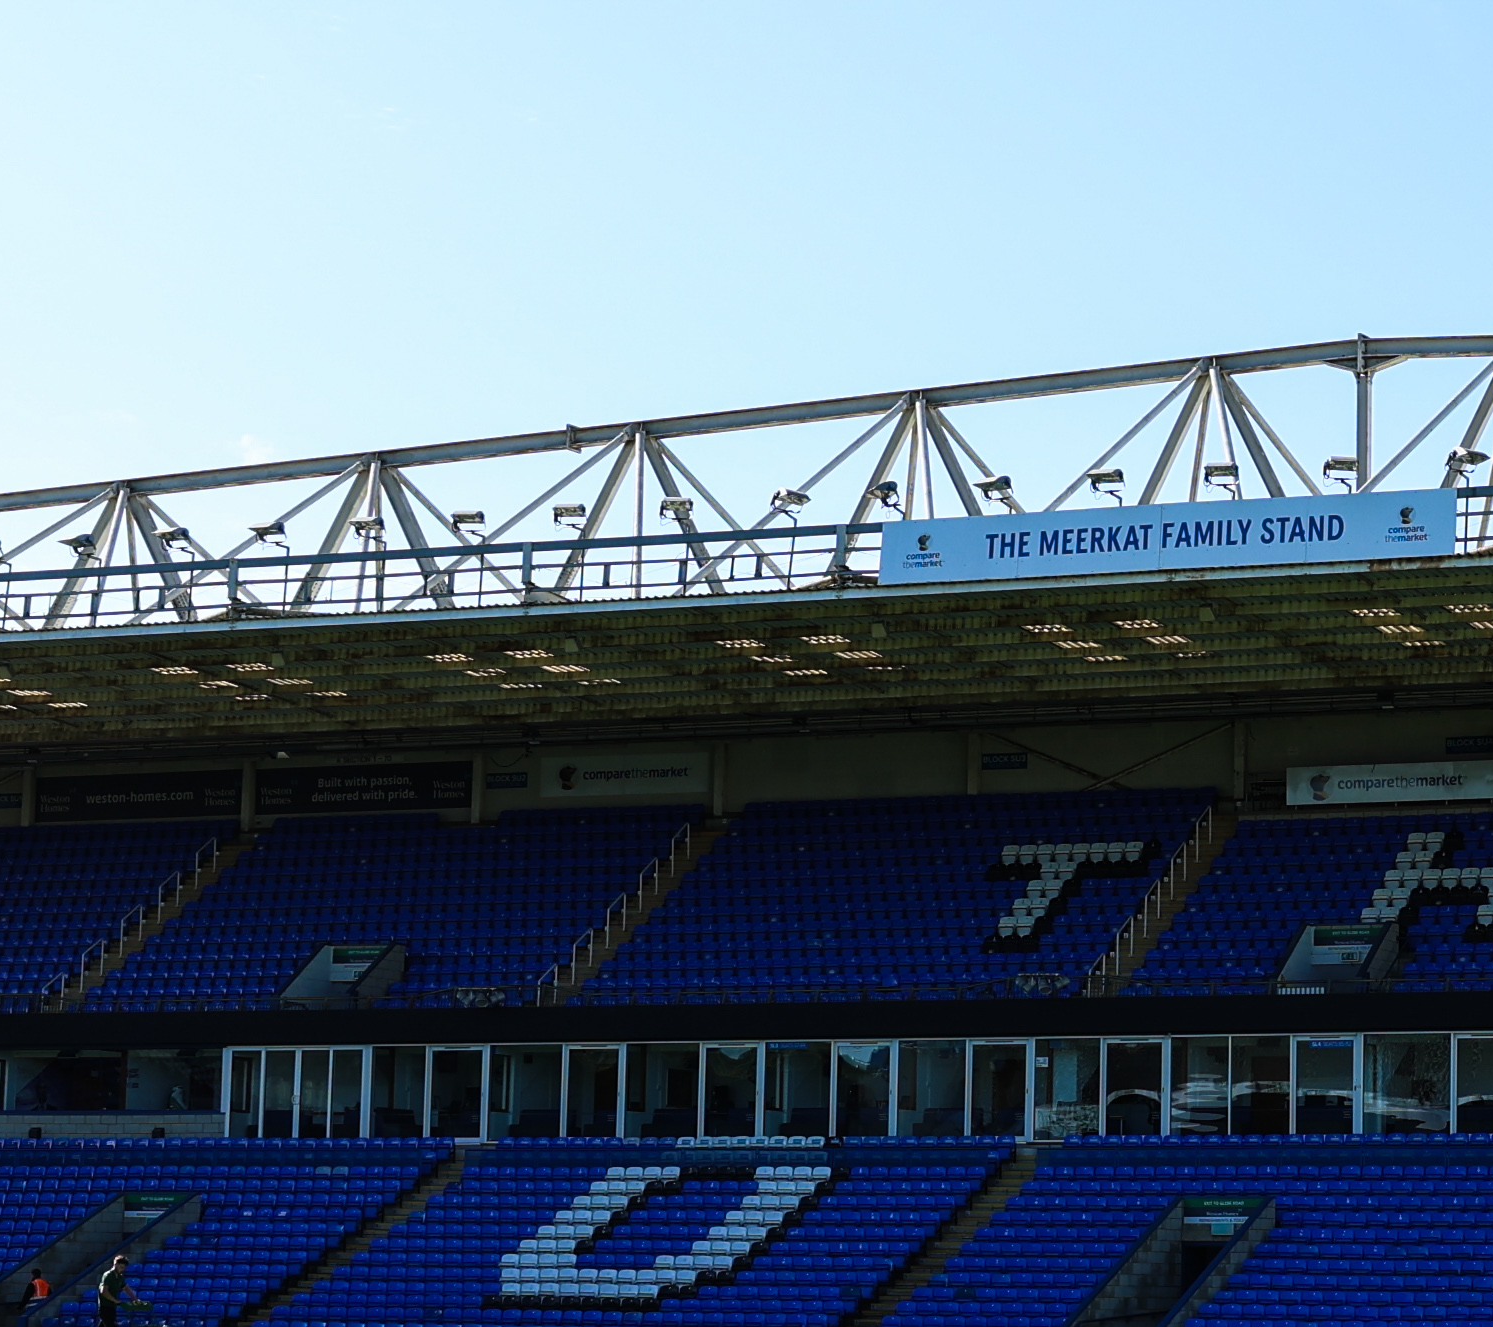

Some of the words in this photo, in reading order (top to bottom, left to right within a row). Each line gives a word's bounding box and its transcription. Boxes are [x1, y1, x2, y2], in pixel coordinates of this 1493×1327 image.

[1388, 524, 1425, 535] compare
[986, 531, 1031, 559] THE
[1039, 524, 1154, 557] MEERKAT
[1161, 518, 1252, 549] FAMILY
[1260, 514, 1345, 545] STAND
[1384, 533, 1428, 543] themarket
[906, 551, 940, 561] compare
[902, 559, 943, 569] themarket
[1447, 739, 1474, 747] BLOCK
[583, 766, 689, 781] comparethemarket
[318, 778, 342, 788] Built
[344, 776, 367, 787] with
[370, 776, 412, 789] passion,
[432, 779, 465, 789] Weston
[1338, 774, 1463, 791] comparethemarket
[204, 787, 236, 797] Weston
[260, 786, 292, 796] Weston
[311, 791, 359, 803] delivered
[362, 789, 386, 800] with
[388, 789, 418, 802] pride.
[433, 789, 465, 799] Homes
[39, 794, 70, 803] Weston
[85, 791, 194, 804] weston-homes.com
[204, 797, 235, 806] Homes
[260, 796, 291, 805] Homes
[40, 803, 70, 813] Homes
